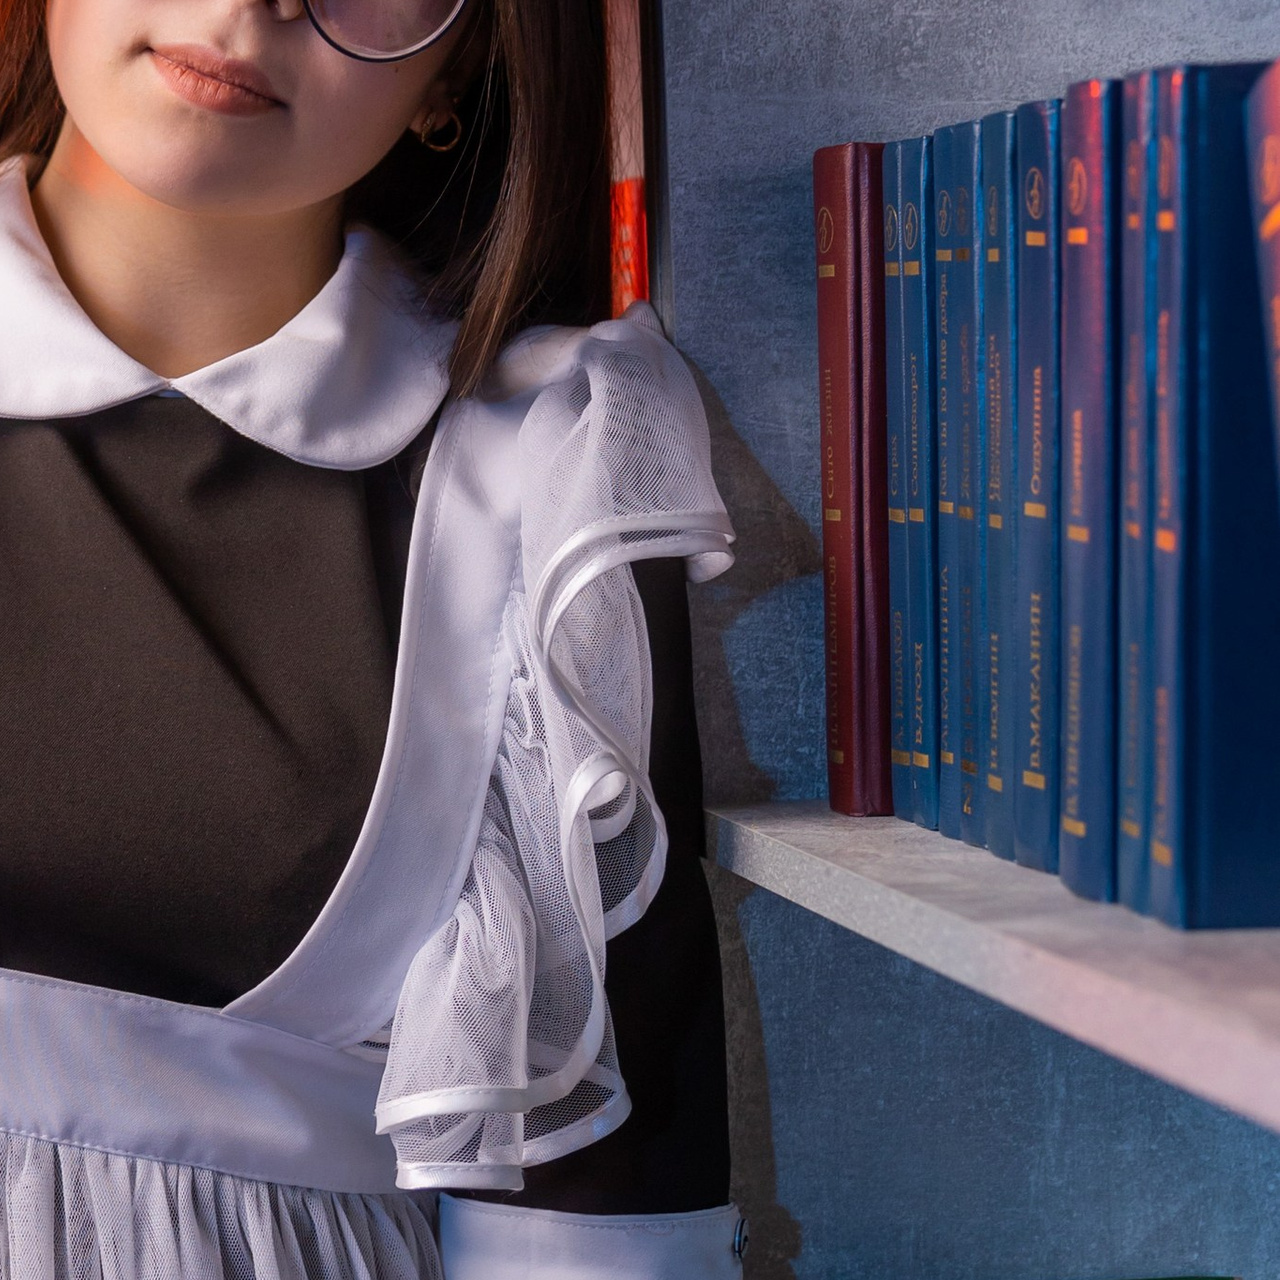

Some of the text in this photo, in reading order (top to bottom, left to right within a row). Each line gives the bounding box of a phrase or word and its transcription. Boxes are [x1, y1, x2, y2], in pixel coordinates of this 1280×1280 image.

[824, 368, 834, 499] Сито жизни
[910, 352, 919, 497] Солнцеворот
[938, 273, 948, 496] Как ты ко мне добра
[890, 434, 899, 496] Страх
